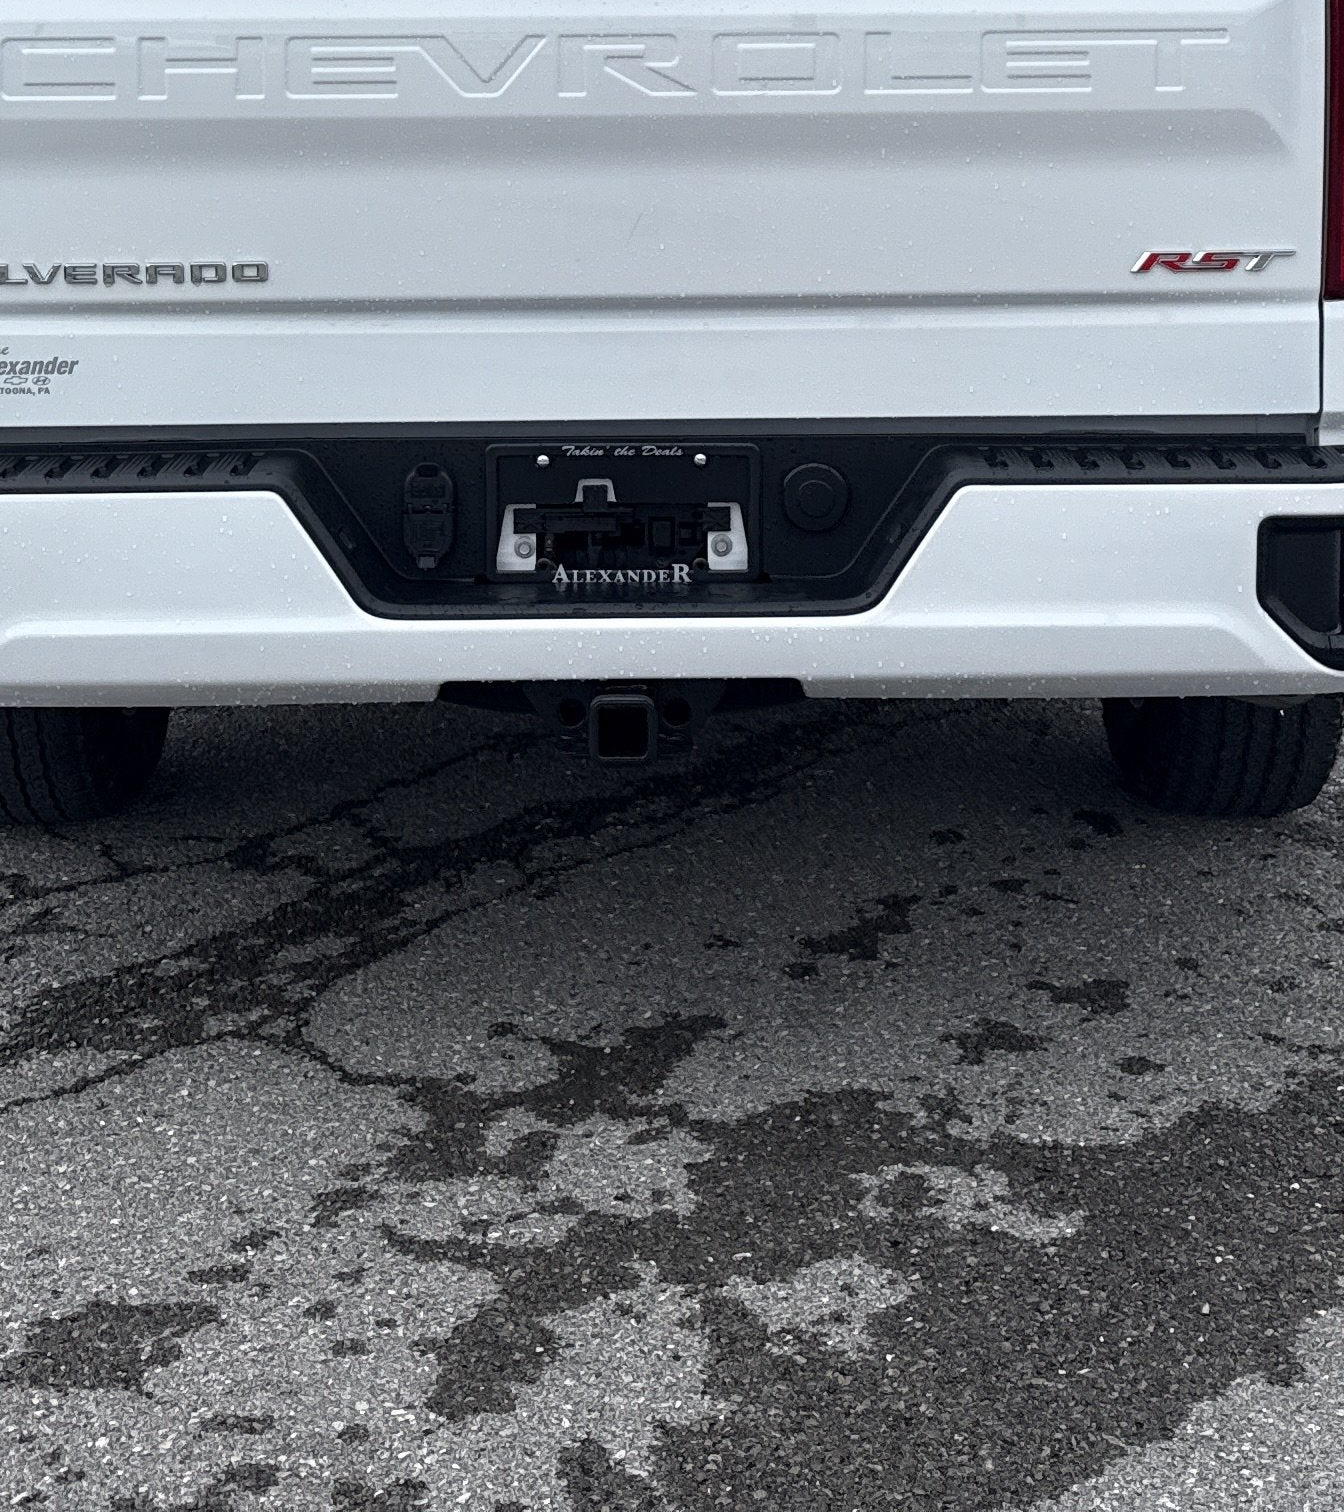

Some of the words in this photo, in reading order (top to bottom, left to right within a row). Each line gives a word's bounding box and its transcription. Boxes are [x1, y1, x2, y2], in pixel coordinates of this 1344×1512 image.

[1, 28, 1231, 102] CHEVROLET
[1130, 249, 1296, 274] RST
[37, 387, 51, 395] PA
[561, 445, 610, 457] Takin'
[614, 445, 636, 456] the
[641, 445, 684, 457] Deals
[552, 563, 693, 583] ALEXANDER
